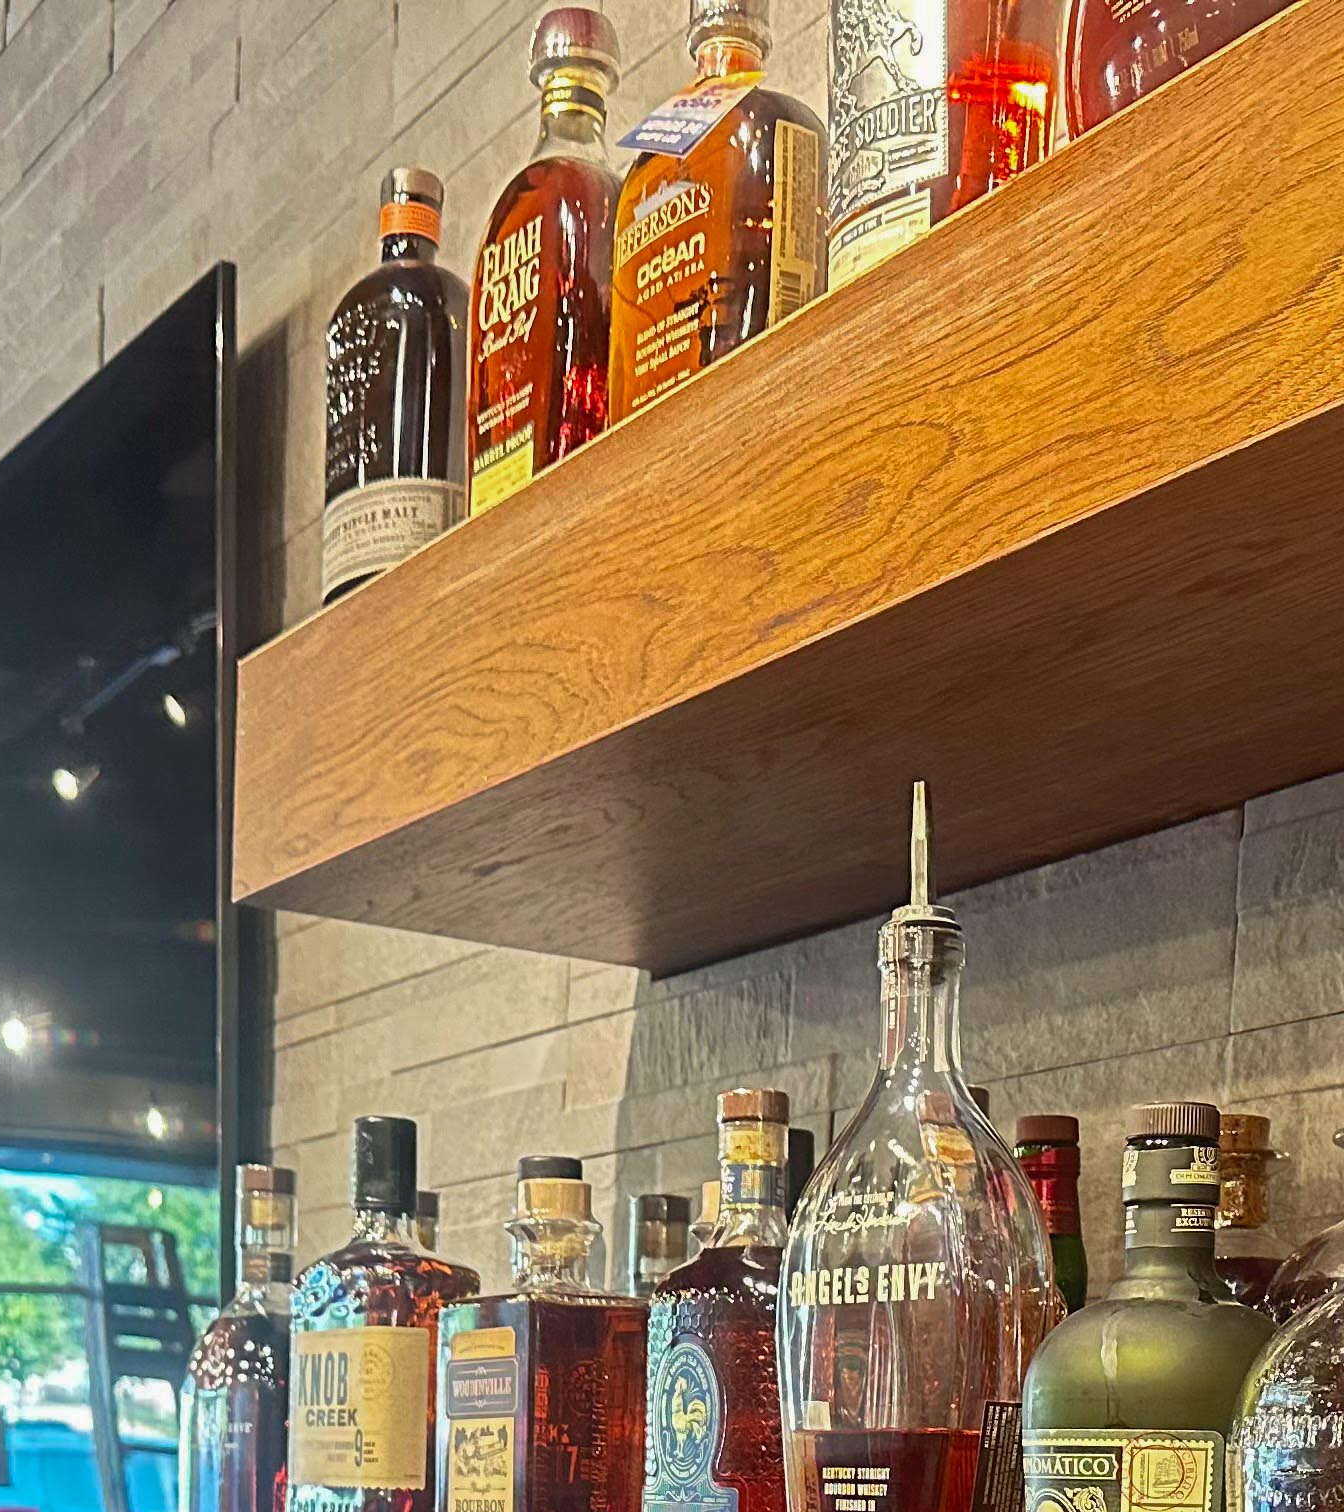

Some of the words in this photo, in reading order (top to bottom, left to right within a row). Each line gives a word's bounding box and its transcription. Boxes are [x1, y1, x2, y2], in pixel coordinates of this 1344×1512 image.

[856, 95, 936, 150] SOLDIER
[616, 182, 712, 273] JEFFERSON'S
[481, 214, 543, 291] ELIJAH
[479, 256, 540, 331] CRAIG
[473, 443, 506, 474] BARREL
[505, 422, 533, 454] PROOF
[382, 505, 418, 521] MALT
[877, 1262, 942, 1303] ENVY
[298, 1351, 350, 1407] KNOB
[306, 1408, 359, 1427] CREEK
[354, 1428, 364, 1467] 9
[822, 1467, 856, 1480] KENTUCKY
[857, 1467, 891, 1480] STRAIGHT
[823, 1482, 856, 1496] BOURBON
[856, 1483, 889, 1497] WHISKEY
[835, 1498, 867, 1512] FINISHED
[867, 1499, 877, 1512] IN
